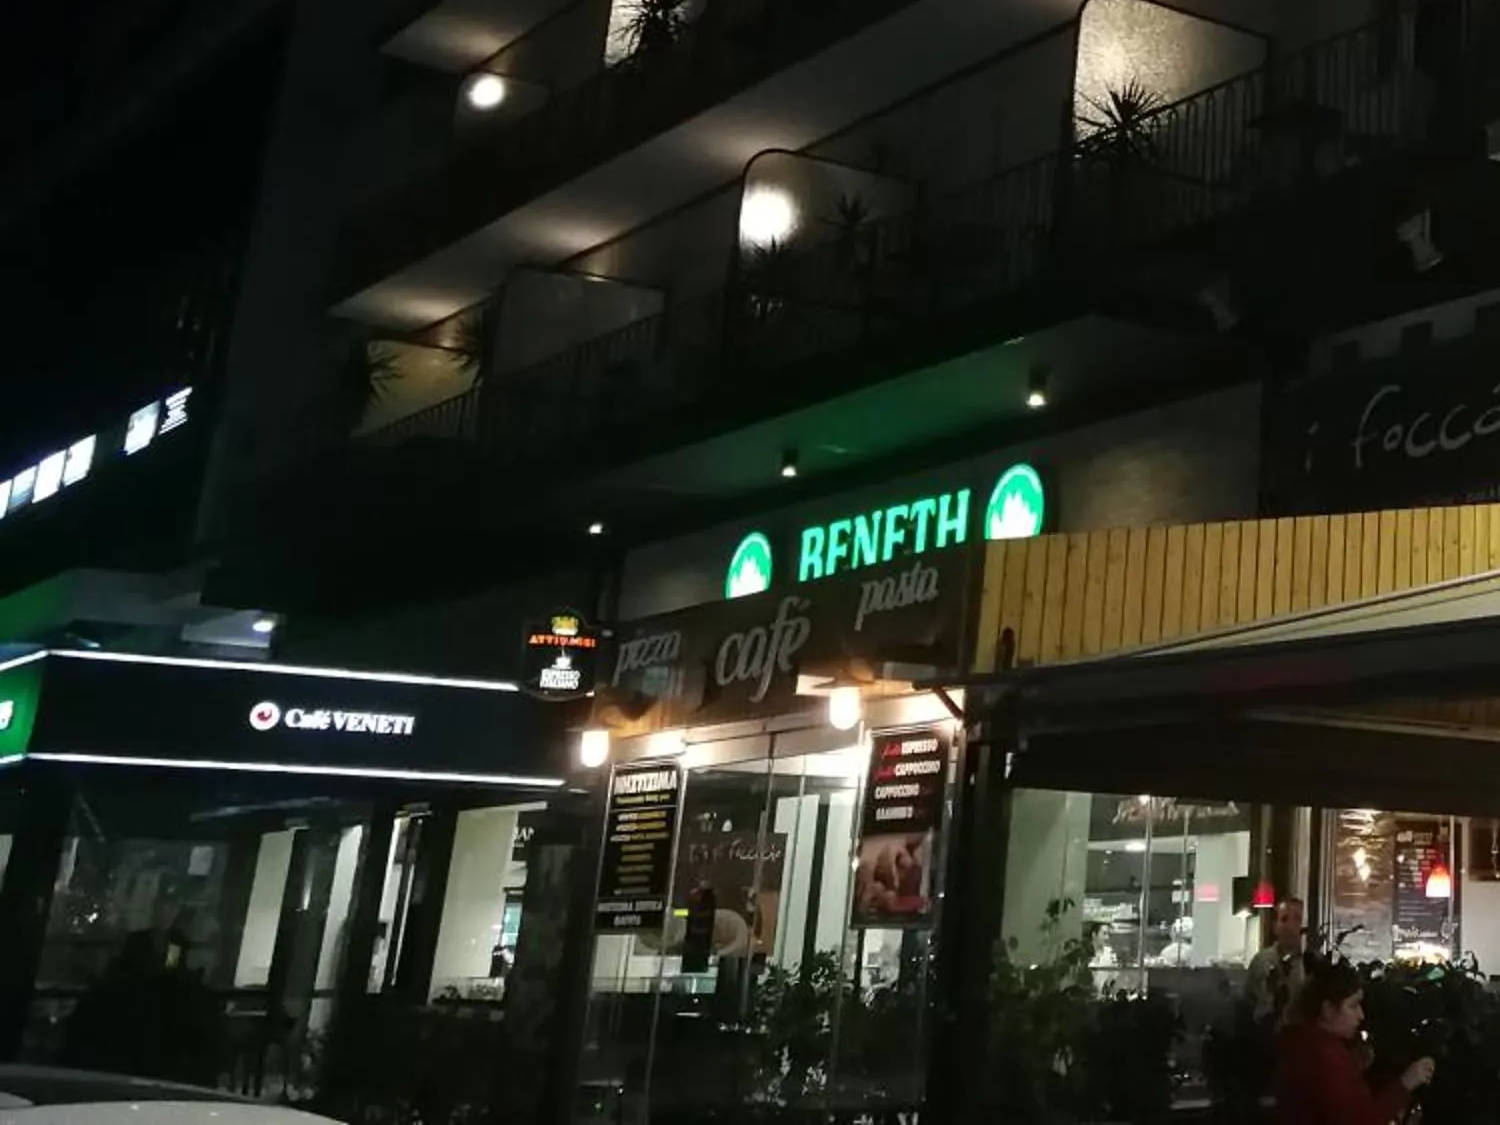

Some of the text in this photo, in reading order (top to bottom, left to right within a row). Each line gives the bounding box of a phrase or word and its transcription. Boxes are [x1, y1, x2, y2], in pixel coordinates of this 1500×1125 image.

[855, 561, 939, 631] pasta
[612, 627, 682, 687] pizza
[716, 596, 811, 703] café
[285, 708, 415, 735] Café VENETI
